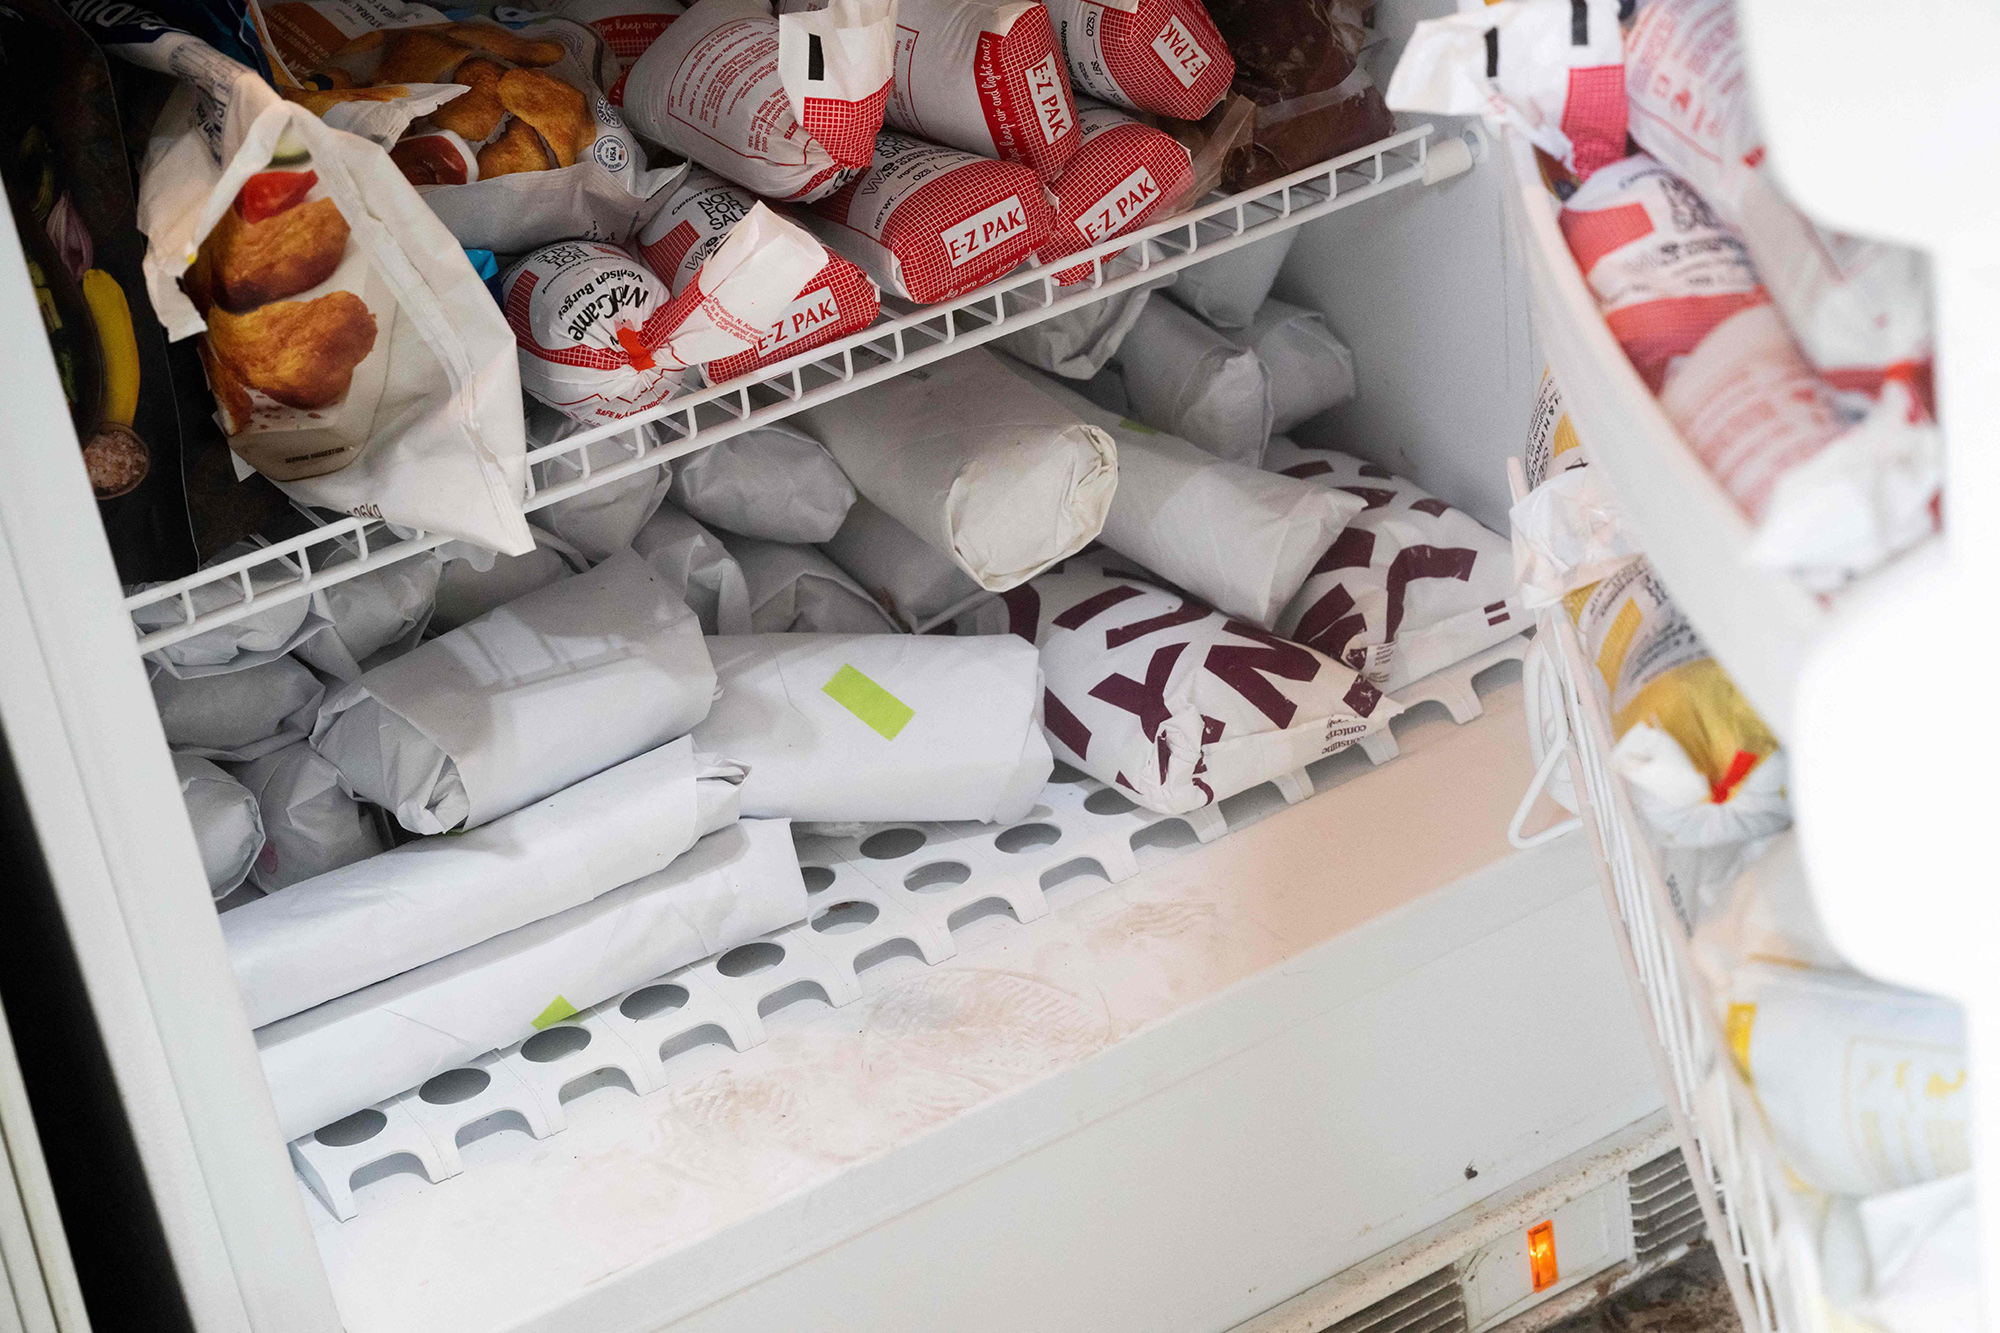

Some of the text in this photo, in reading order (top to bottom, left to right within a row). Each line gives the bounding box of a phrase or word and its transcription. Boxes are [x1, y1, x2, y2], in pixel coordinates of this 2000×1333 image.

[615, 19, 641, 33] keep
[643, 20, 658, 28] air
[1086, 11, 1097, 36] OZS.)
[980, 37, 994, 62] out!
[1160, 24, 1189, 58] PAK
[1182, 48, 1206, 78] E-Z
[978, 62, 1002, 90] light
[987, 88, 1003, 107] and
[1033, 61, 1068, 138] E-Z PAK
[994, 108, 1008, 122] air
[997, 123, 1016, 147] keep
[897, 161, 924, 180] Ingram,
[913, 164, 934, 180] OZS.
[672, 191, 703, 215] Custom
[697, 191, 733, 210] NOT
[704, 199, 744, 219] FOR
[1084, 176, 1155, 243] E-Z PAK
[949, 207, 1022, 261] E-Z PAK
[555, 248, 588, 270] NOT
[557, 284, 594, 320] Burger
[713, 297, 735, 322] Division,
[735, 318, 744, 326] N.
[709, 304, 717, 312] is
[719, 315, 749, 336] registered
[715, 320, 729, 331] Call
[757, 299, 834, 352] E-Z PAK
[596, 409, 614, 418] SAFE
[286, 447, 345, 463] SERVING SUGGESTION
